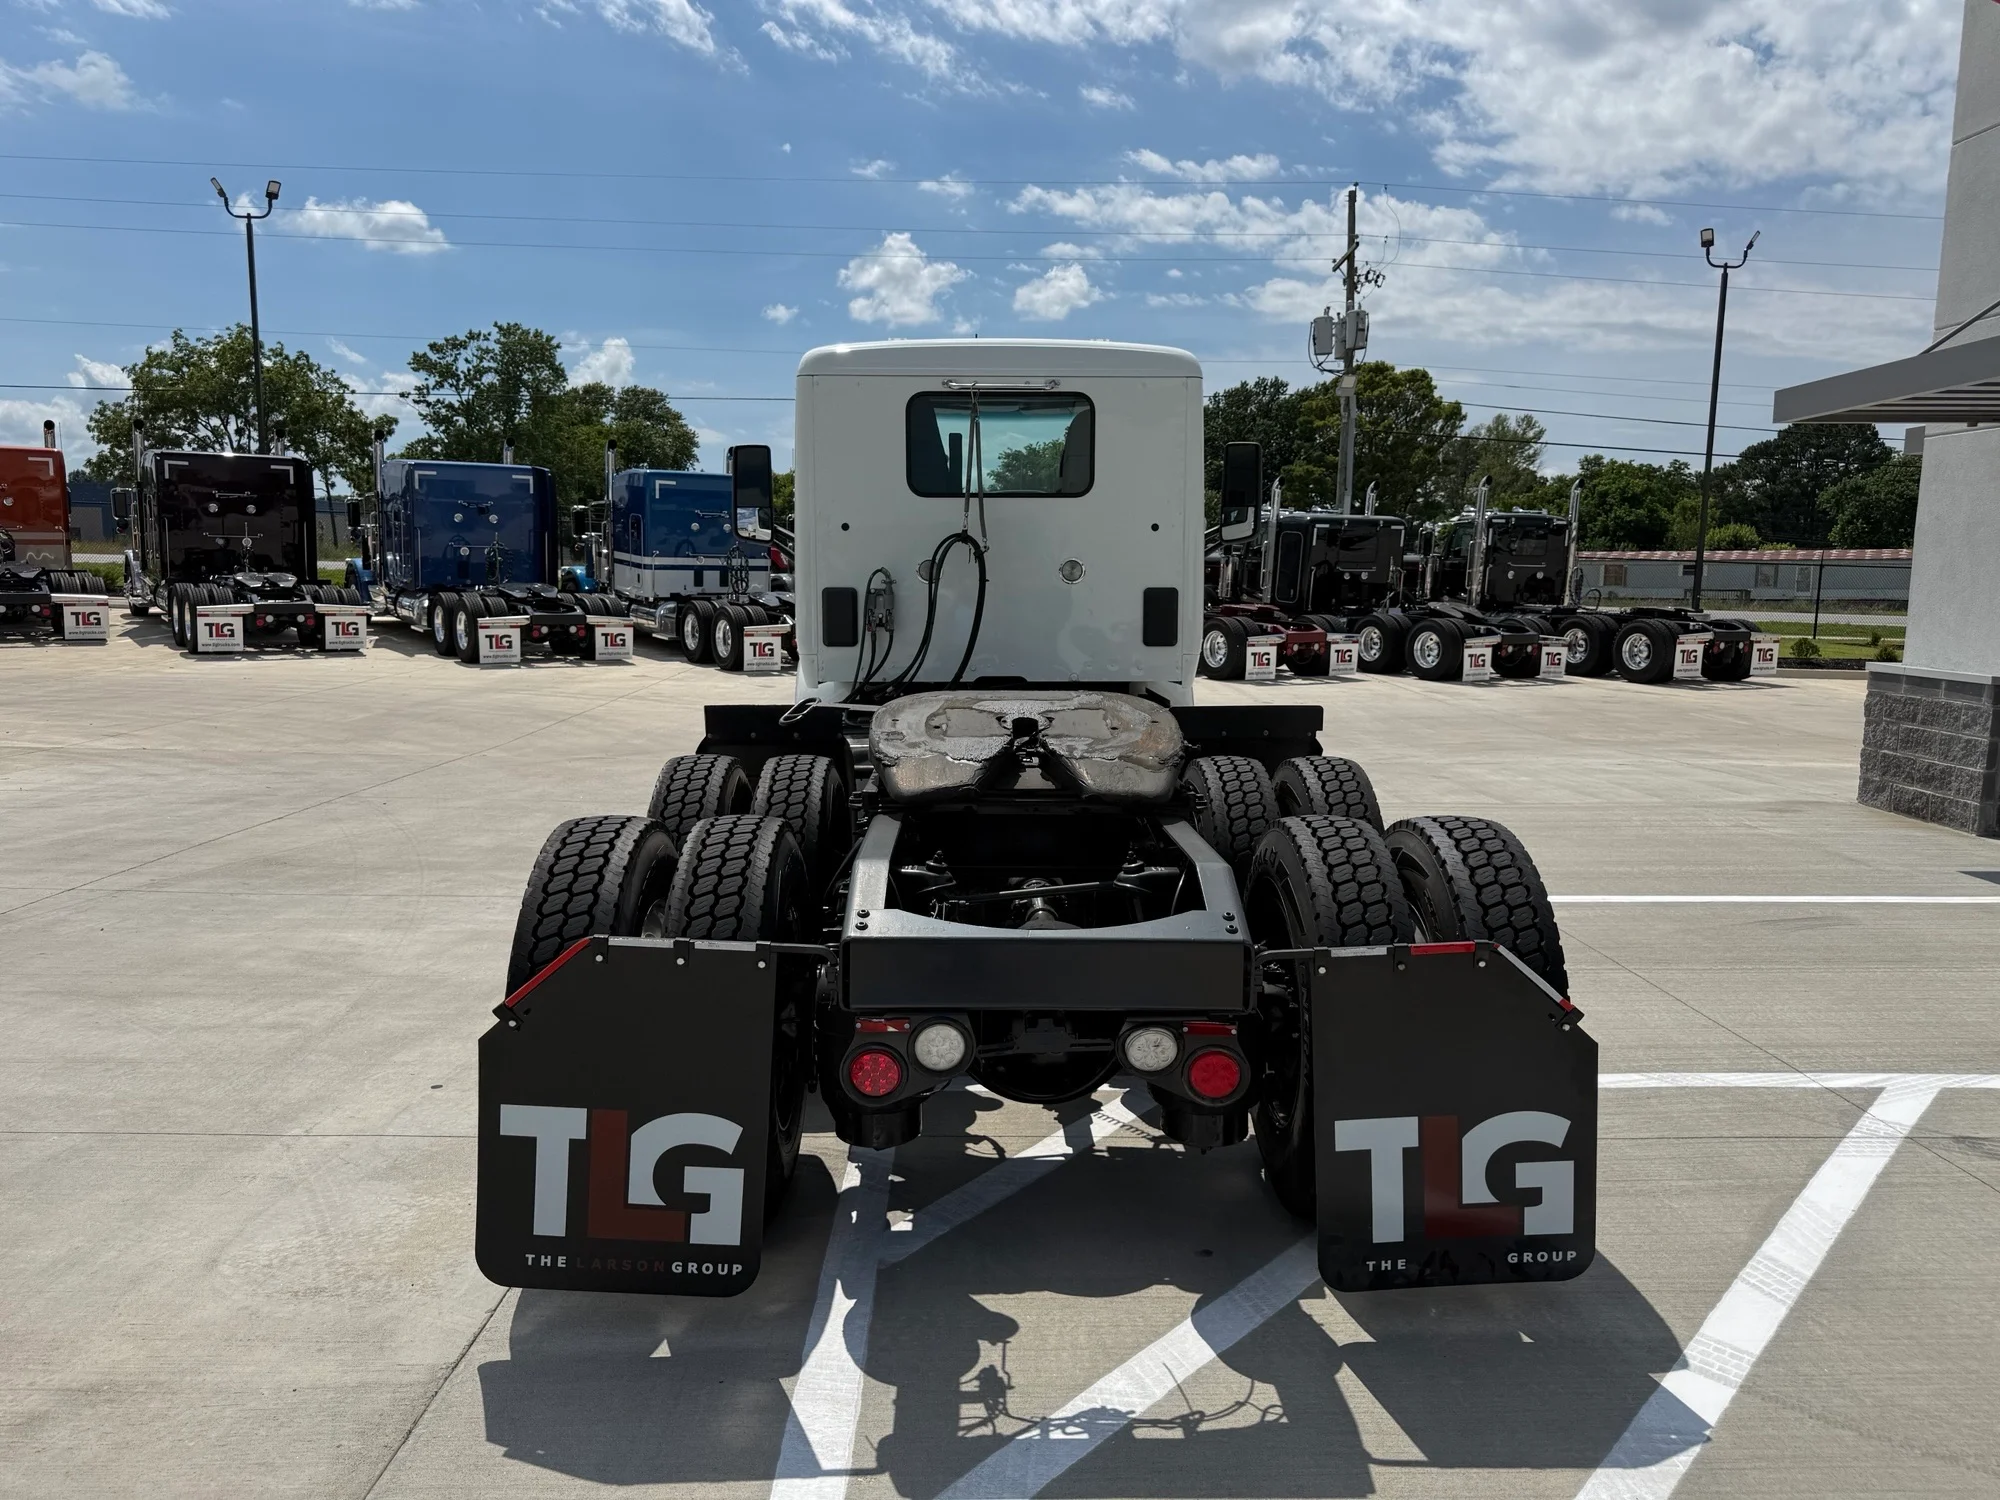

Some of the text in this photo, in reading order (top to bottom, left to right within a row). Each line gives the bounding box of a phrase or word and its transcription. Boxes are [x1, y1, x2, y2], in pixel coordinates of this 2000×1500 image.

[70, 612, 102, 626] TLG
[204, 623, 235, 638] TLG
[331, 621, 360, 636] TLG
[485, 634, 513, 650] TLG
[601, 633, 626, 647] TLG
[749, 642, 775, 657] TLG
[1334, 649, 1353, 664] TLG
[1680, 649, 1698, 664] TLG
[1756, 648, 1774, 663] TLG
[1251, 652, 1271, 667] TLG
[1468, 654, 1486, 668] TLG
[1545, 652, 1562, 666] TLG
[499, 1103, 745, 1246] TLG
[1334, 1110, 1575, 1244] TLG
[525, 1253, 743, 1276] THE LARSON GROUP
[1366, 1250, 1578, 1272] THE GROUP
